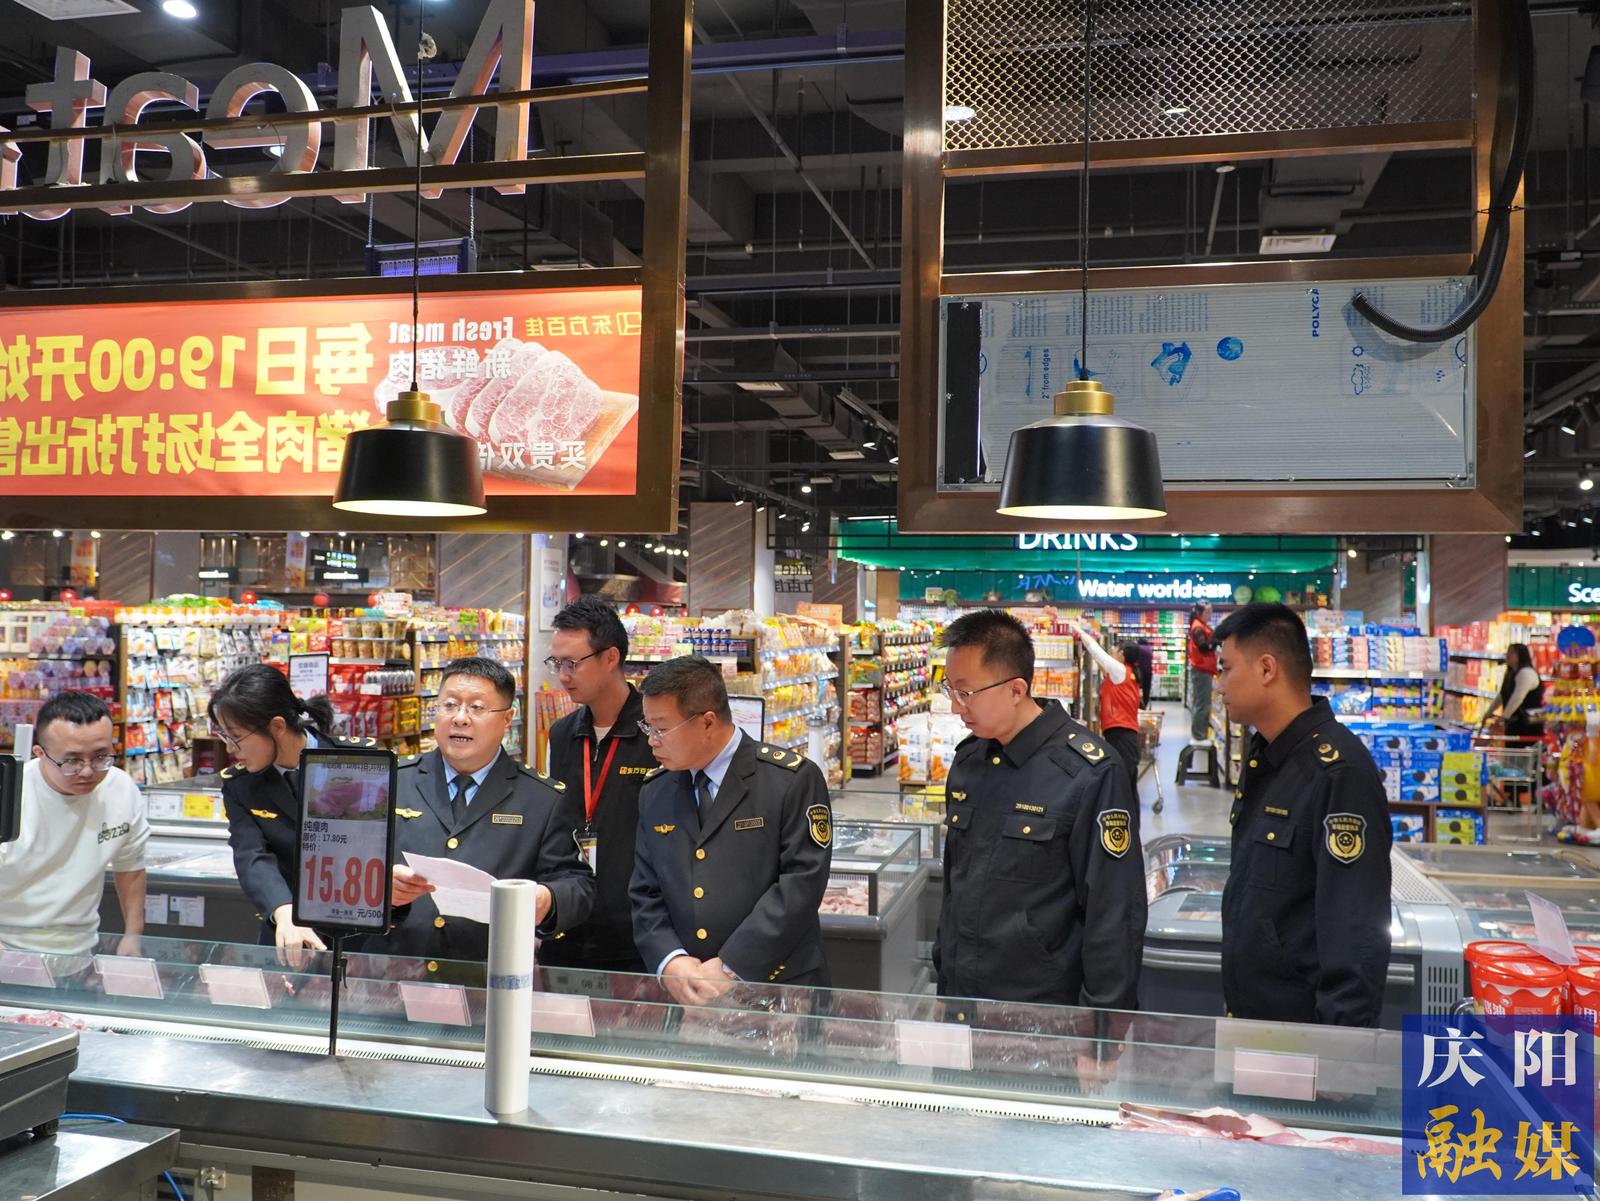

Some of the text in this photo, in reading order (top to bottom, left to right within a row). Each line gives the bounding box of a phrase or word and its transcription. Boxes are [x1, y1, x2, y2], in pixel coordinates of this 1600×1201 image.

[1042, 348, 1051, 371] edges
[1042, 373, 1050, 391] from
[1078, 579, 1135, 598] Water
[1137, 579, 1192, 599] world
[305, 854, 385, 908] 15.80
